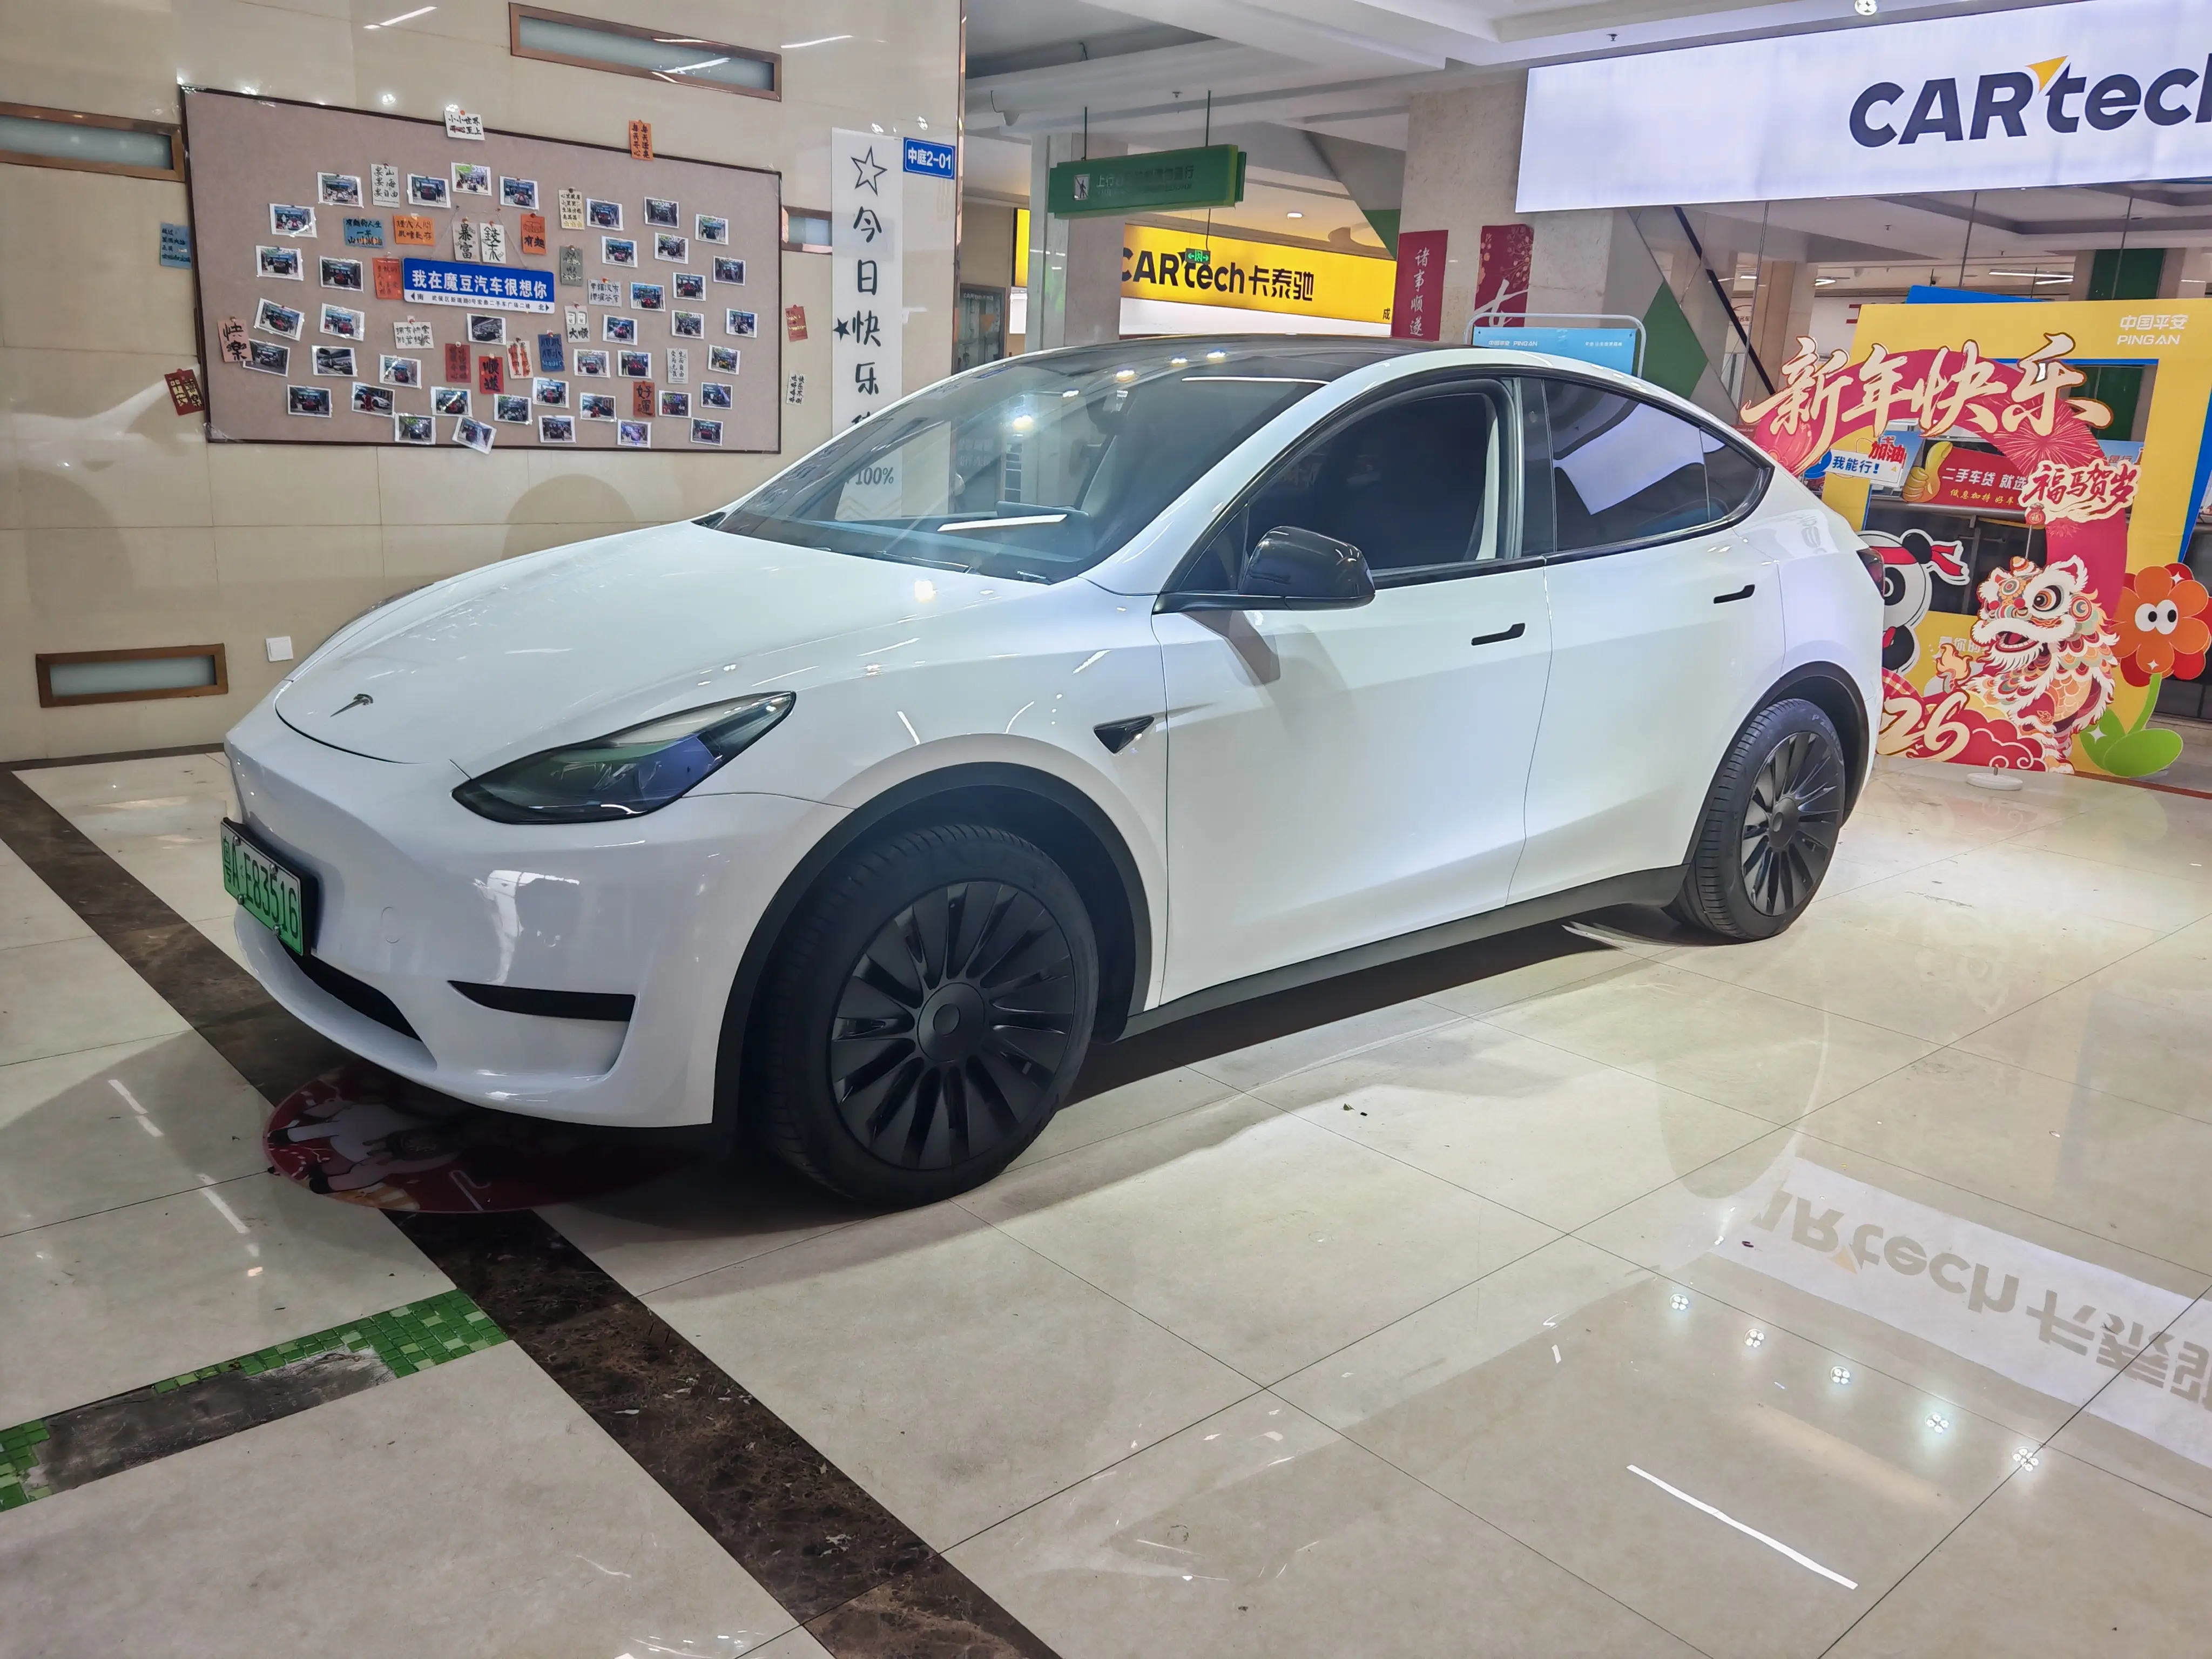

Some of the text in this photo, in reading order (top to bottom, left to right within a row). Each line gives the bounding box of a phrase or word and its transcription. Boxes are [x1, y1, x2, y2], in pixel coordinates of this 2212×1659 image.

[448, 114, 480, 126] 小小世界
[907, 146, 952, 170] 中庭2-01
[458, 223, 473, 259] 暴富
[412, 269, 548, 299] 我在魔豆汽车很想你
[1249, 265, 1314, 301] 卡泰驰
[1410, 247, 1430, 336] 诸事顺遂
[1382, 308, 1391, 320] 成
[2120, 314, 2188, 331] 中国平安
[569, 327, 589, 340] 大顺
[2117, 334, 2180, 345] PINGAN
[1741, 333, 2113, 474] 新年快乐
[1868, 440, 1907, 466] 加油
[855, 467, 894, 485] 100%
[1942, 468, 1996, 487] 二手车贷
[1950, 489, 2019, 505] 低息加持 好车
[2022, 463, 2137, 516] 福马贺岁
